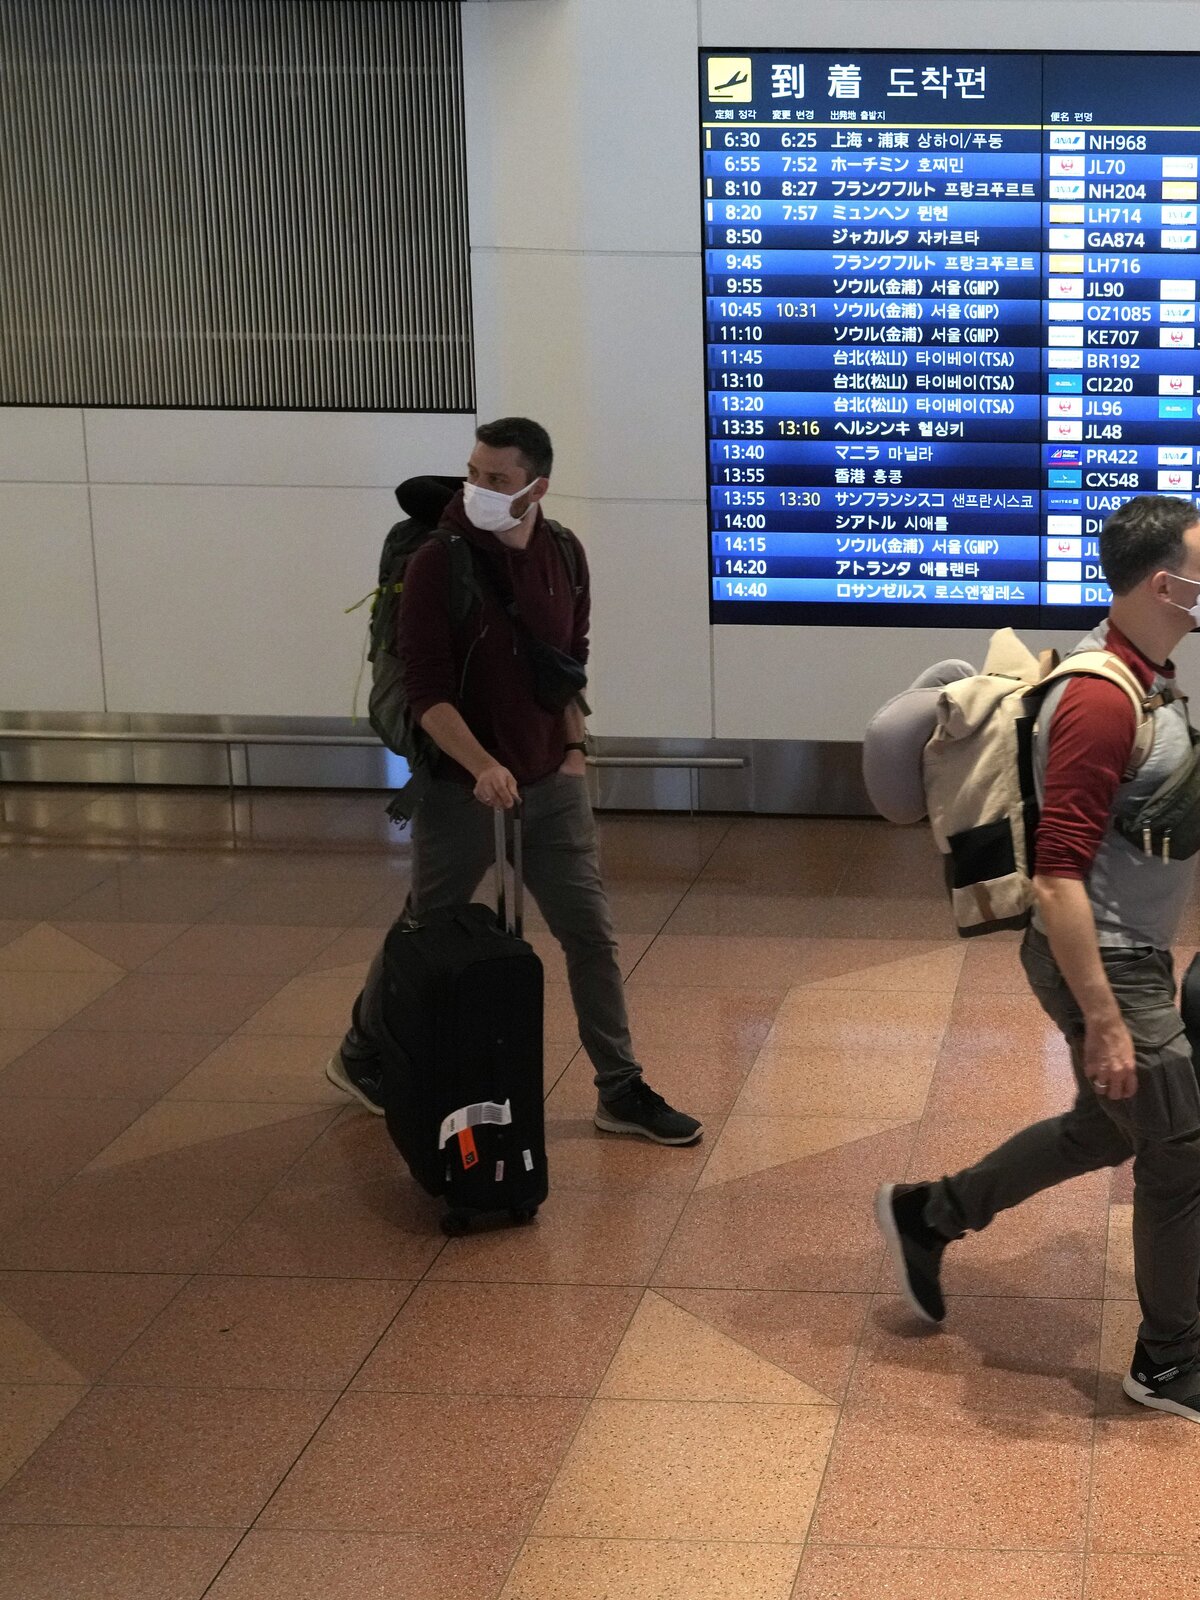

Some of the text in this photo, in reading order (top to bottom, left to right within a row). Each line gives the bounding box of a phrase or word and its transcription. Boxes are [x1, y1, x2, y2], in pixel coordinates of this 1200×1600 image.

[771, 64, 861, 99] 到 着
[886, 65, 986, 100] 도착편
[715, 109, 734, 120] 定刻
[796, 110, 814, 120] 변경
[1050, 112, 1069, 122] 便名
[725, 132, 816, 147] 6:30 6:25
[831, 132, 909, 148] 上海・浦東
[1090, 135, 1146, 150] NH968
[725, 157, 817, 172] 6:55 7:52
[832, 157, 963, 173] ホーチミン 호찌민
[1088, 160, 1125, 174] JL70
[725, 181, 817, 196] 8:10 8:27
[832, 181, 1035, 197] フランクフルト 프랑크푸르트
[1089, 184, 1146, 199] NH204
[726, 205, 817, 220] 8:20 7:57
[833, 205, 909, 220] ミュンヘン
[1089, 208, 1141, 223] LH714
[726, 229, 762, 244] 8:50
[833, 228, 979, 246] ジャカルタ 자카르타
[1088, 232, 1145, 247] GA874
[726, 255, 762, 269] 9:45
[833, 255, 1034, 271] フランクフルト 프랑크푸르트
[1088, 258, 1140, 273] LH716
[727, 278, 762, 293] 9:55
[834, 279, 922, 295] ソウル(金浦)
[1086, 282, 1124, 298] JL90
[720, 302, 815, 317] 10:45 10:31
[834, 303, 923, 319] ソウル(金浦)
[1087, 306, 1151, 321] OZ1085
[721, 326, 762, 340] 11:10
[834, 326, 923, 343] ソウル(金浦)
[1088, 330, 1139, 344] KE707
[722, 350, 762, 364] 11:45
[833, 350, 1014, 366] 台北(松山) 타이베이(TSA)
[1088, 354, 1139, 368] BR192
[722, 373, 763, 387] 13:10
[834, 373, 1014, 390] 台北(松山) 타이베이(TSA)
[1087, 378, 1133, 392] CI220
[722, 397, 763, 411] 13:20
[834, 397, 1014, 414] 台北(松山) 타이베이(TSA)
[1086, 401, 1122, 416] JL96
[723, 420, 819, 435] 13:35 13:16
[835, 421, 910, 436] ヘルシンキ
[1086, 425, 1122, 439] JL48
[724, 445, 764, 459] 13:40
[835, 446, 933, 461] マニラ 마닐라
[1087, 449, 1137, 464] PR422
[724, 468, 764, 482] 13:55
[835, 468, 902, 484] 香港 홍콩
[1086, 473, 1138, 487] CX548
[725, 491, 820, 506] 13:55 13:30
[835, 492, 1033, 508] サンフランシスコ 샌프란시스코
[725, 514, 765, 528] 14:00
[836, 515, 896, 529] シアトル
[725, 537, 766, 551] 14:15
[837, 538, 924, 554] ソウル(金浦)
[726, 560, 766, 574] 14:20
[836, 561, 910, 576] アトランタ
[726, 583, 767, 597] 14:40
[837, 583, 926, 599] ロサンゼルス
